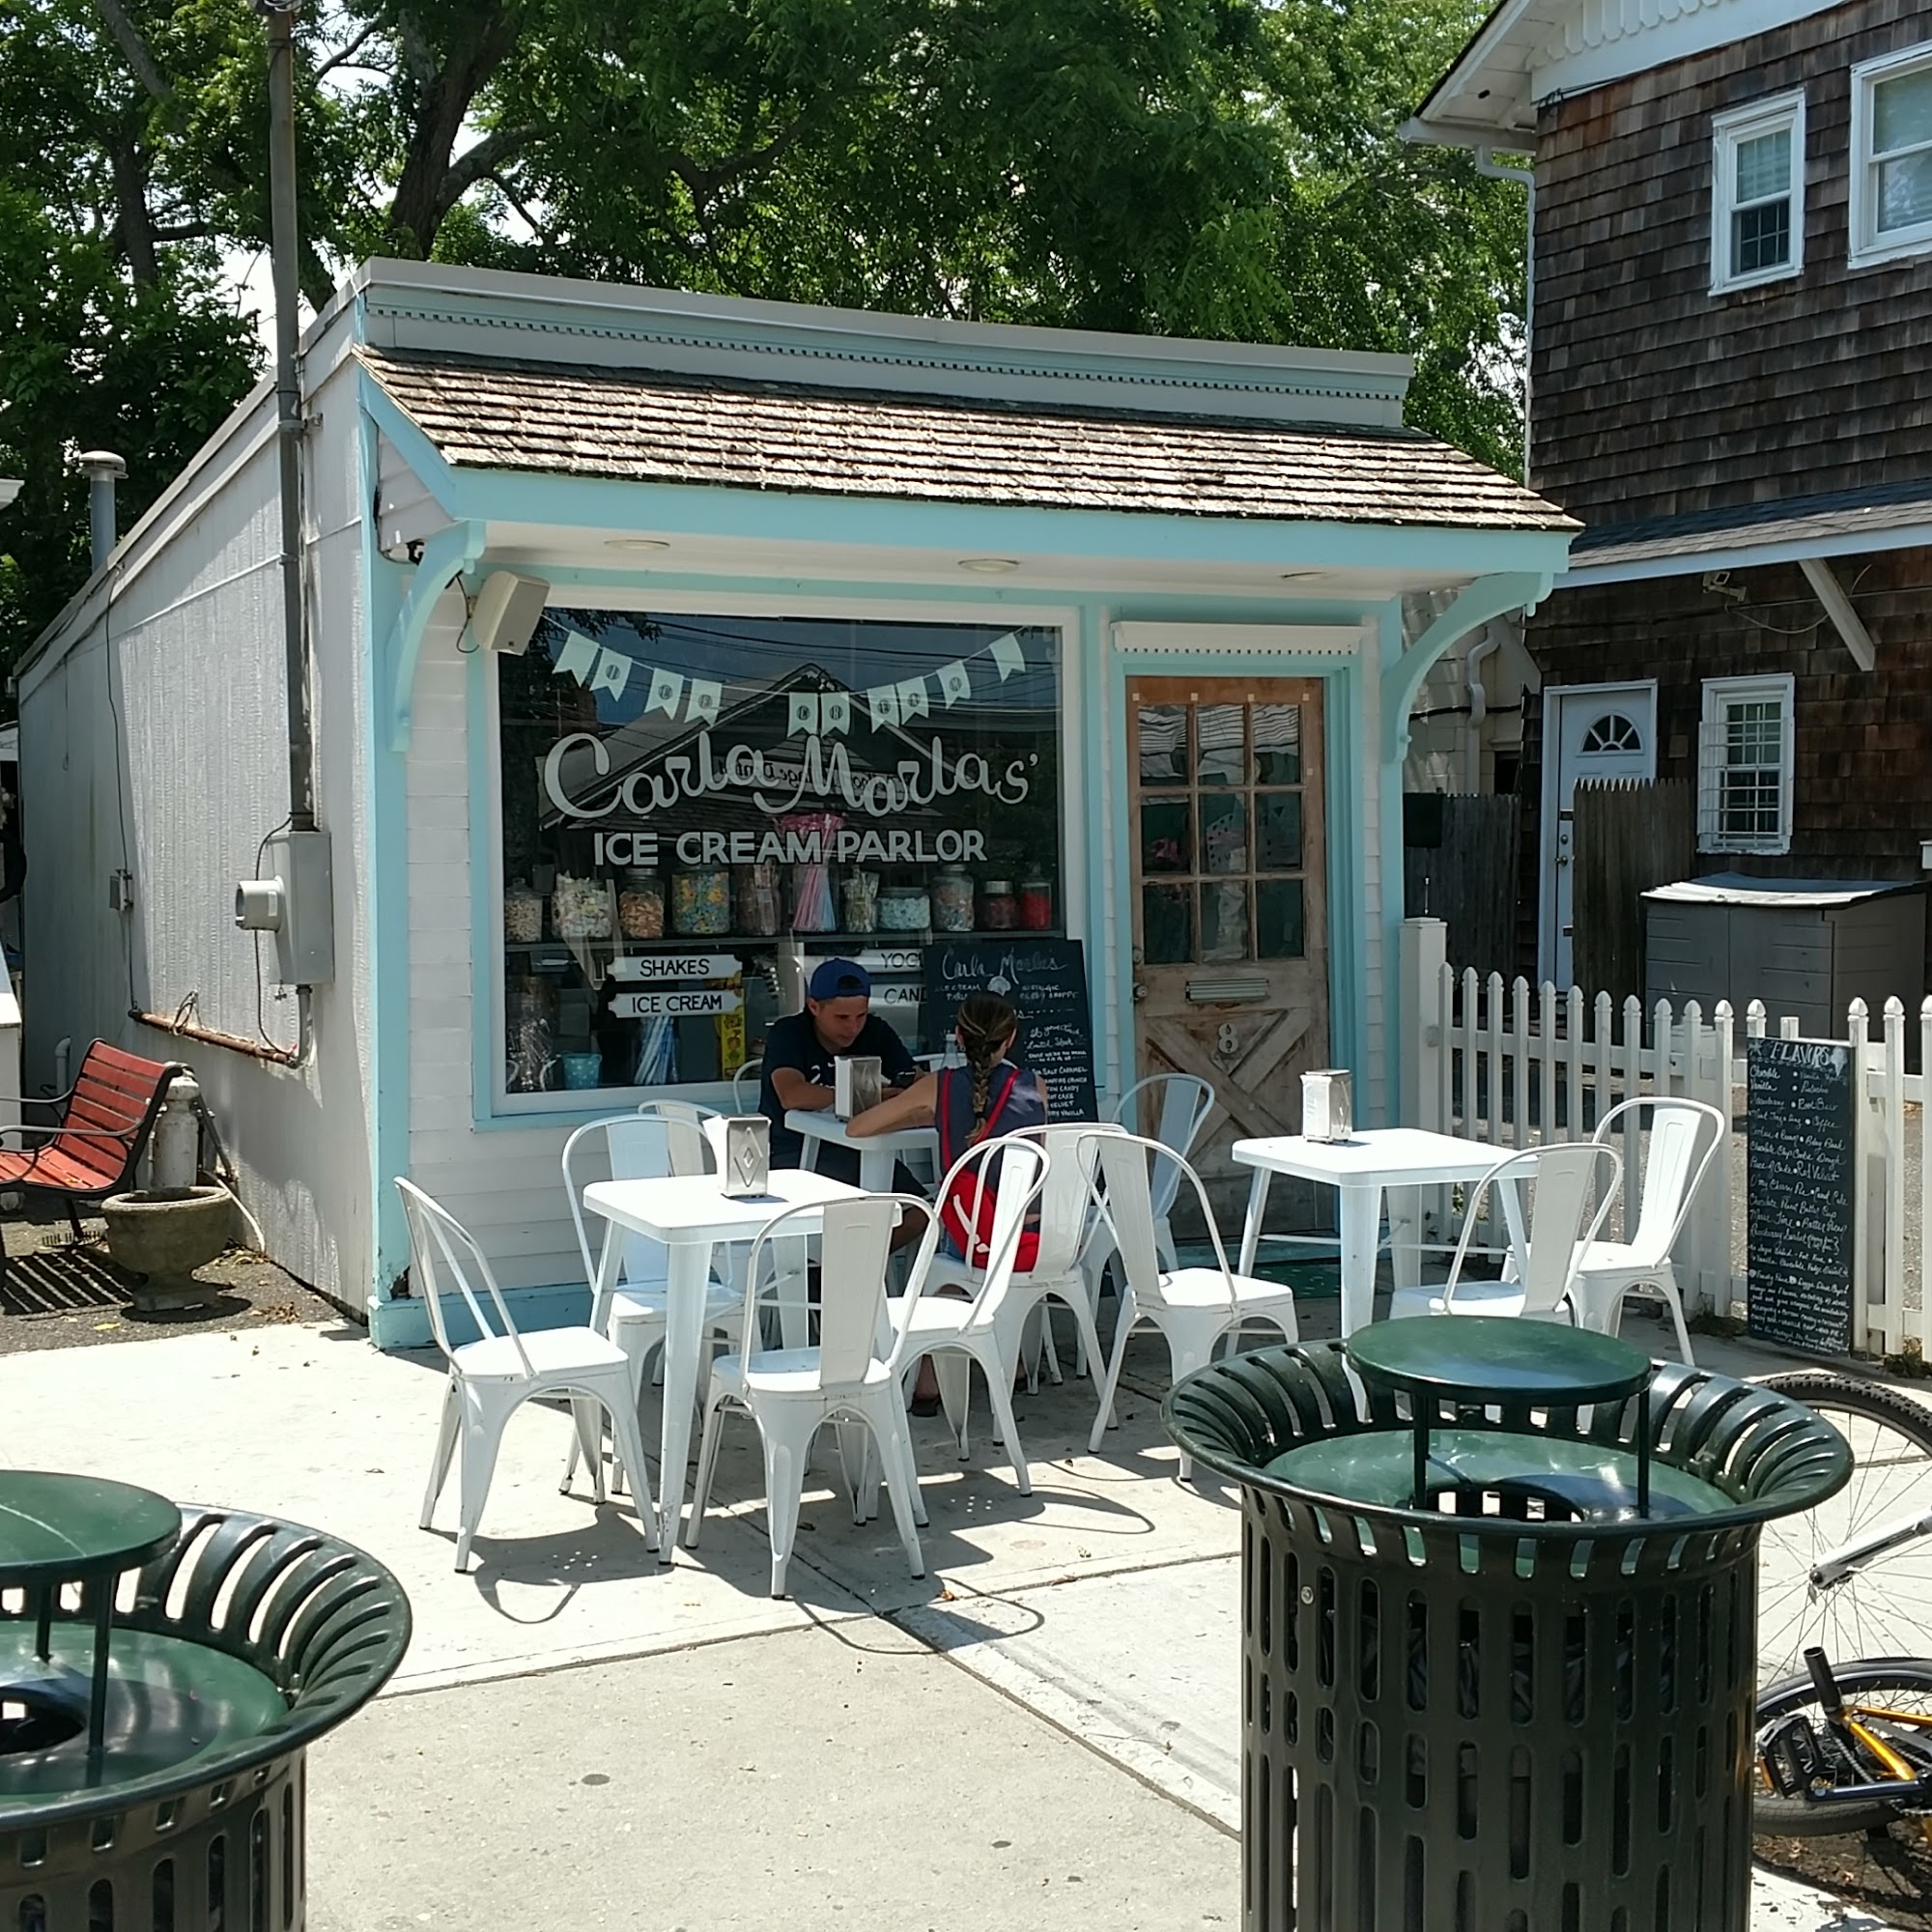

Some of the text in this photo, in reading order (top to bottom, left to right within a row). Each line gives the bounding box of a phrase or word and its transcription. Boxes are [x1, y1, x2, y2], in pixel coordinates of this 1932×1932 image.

[543, 730, 779, 819] Carla
[594, 829, 988, 866] ICE CREAM PARLOR
[639, 959, 710, 978] SHAKES
[942, 948, 994, 980] Carla
[632, 994, 723, 1013] ICE CREAM
[1218, 1022, 1238, 1054] 8
